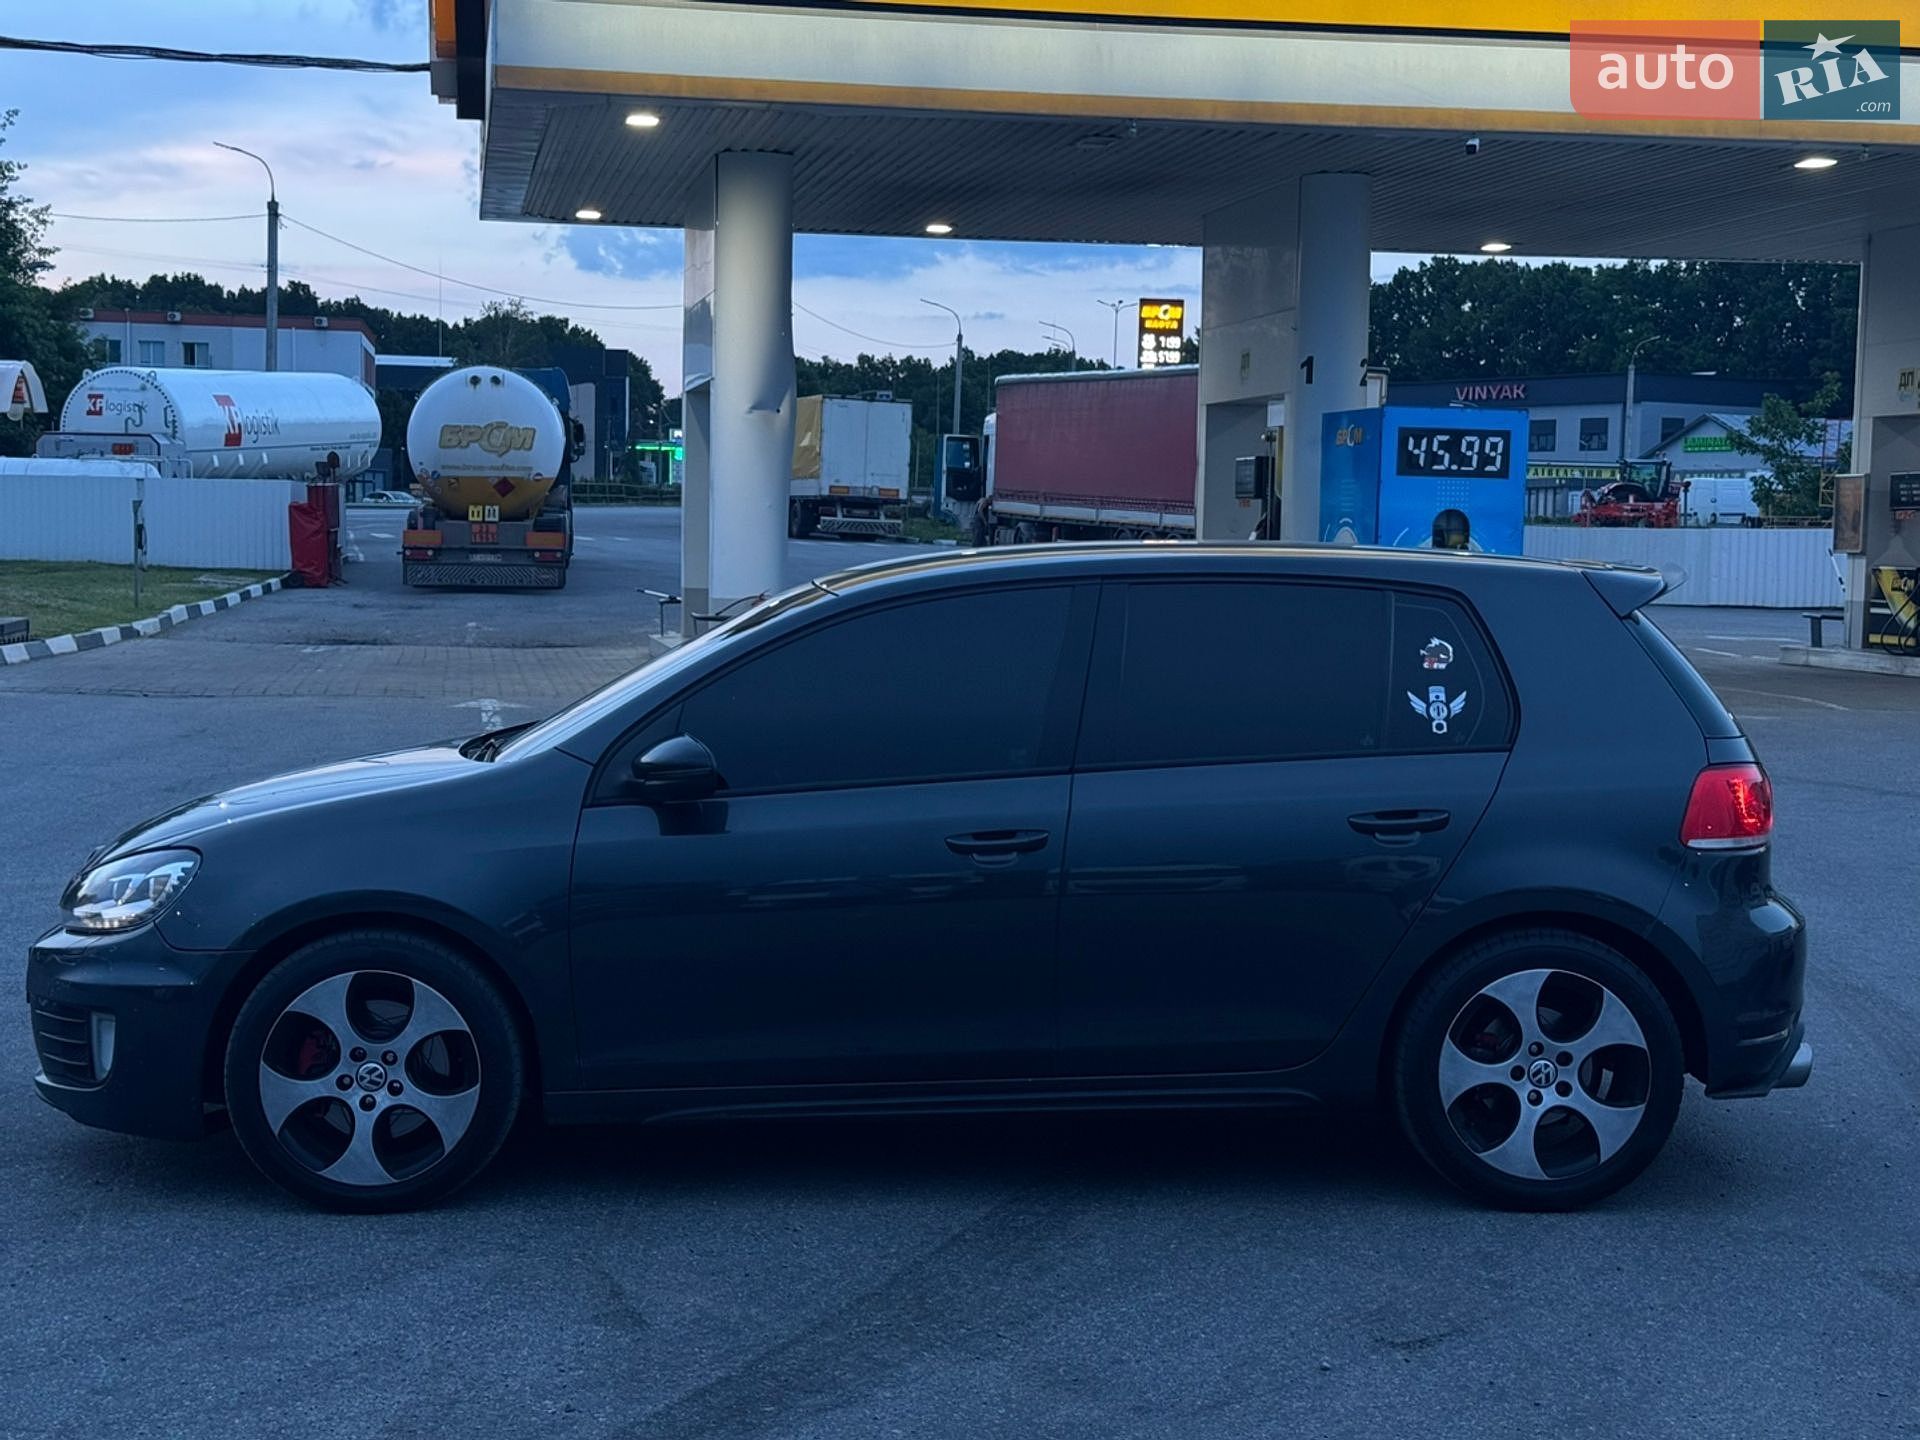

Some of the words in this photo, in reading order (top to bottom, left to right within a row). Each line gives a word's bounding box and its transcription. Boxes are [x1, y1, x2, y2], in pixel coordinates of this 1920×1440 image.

[1300, 356, 1314, 384] 1
[1455, 384, 1525, 401] VINYAK
[1407, 434, 1504, 472] 45.99
